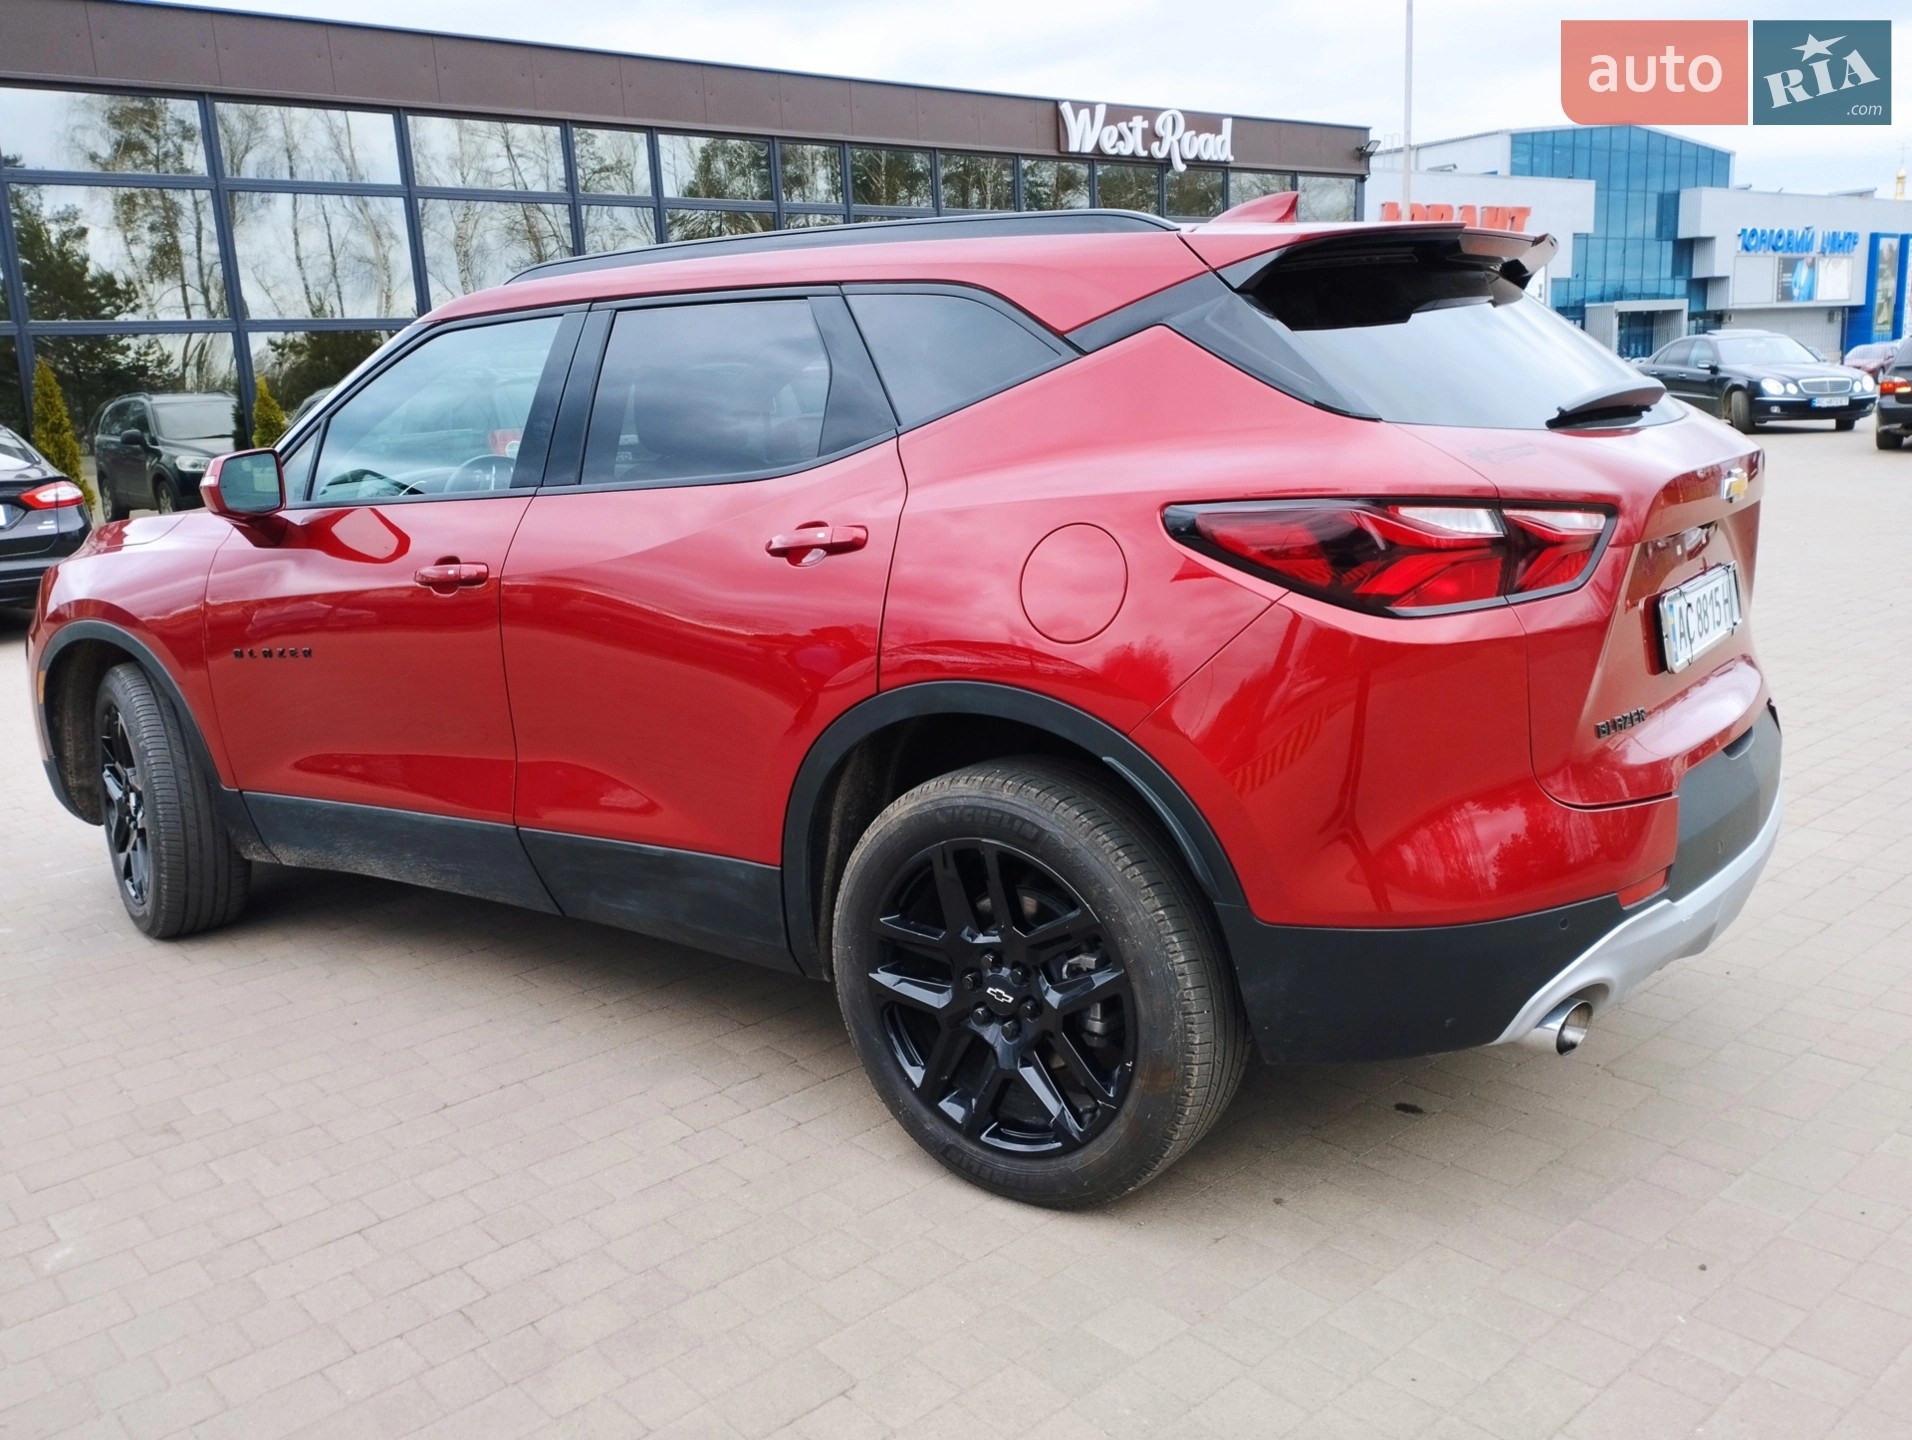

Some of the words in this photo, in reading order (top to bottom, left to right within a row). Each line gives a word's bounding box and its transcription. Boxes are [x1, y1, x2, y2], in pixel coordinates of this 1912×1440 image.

[1059, 101, 1149, 157] West
[1151, 109, 1235, 173] Road
[1737, 224, 1815, 254] ТОРГОВИЙ
[1817, 230, 1860, 256] ЦЕНТР
[1696, 586, 1722, 638] 8815
[233, 647, 313, 659] BLAZER
[1595, 706, 1646, 740] BLAZER
[936, 806, 1040, 841] MICHELIN
